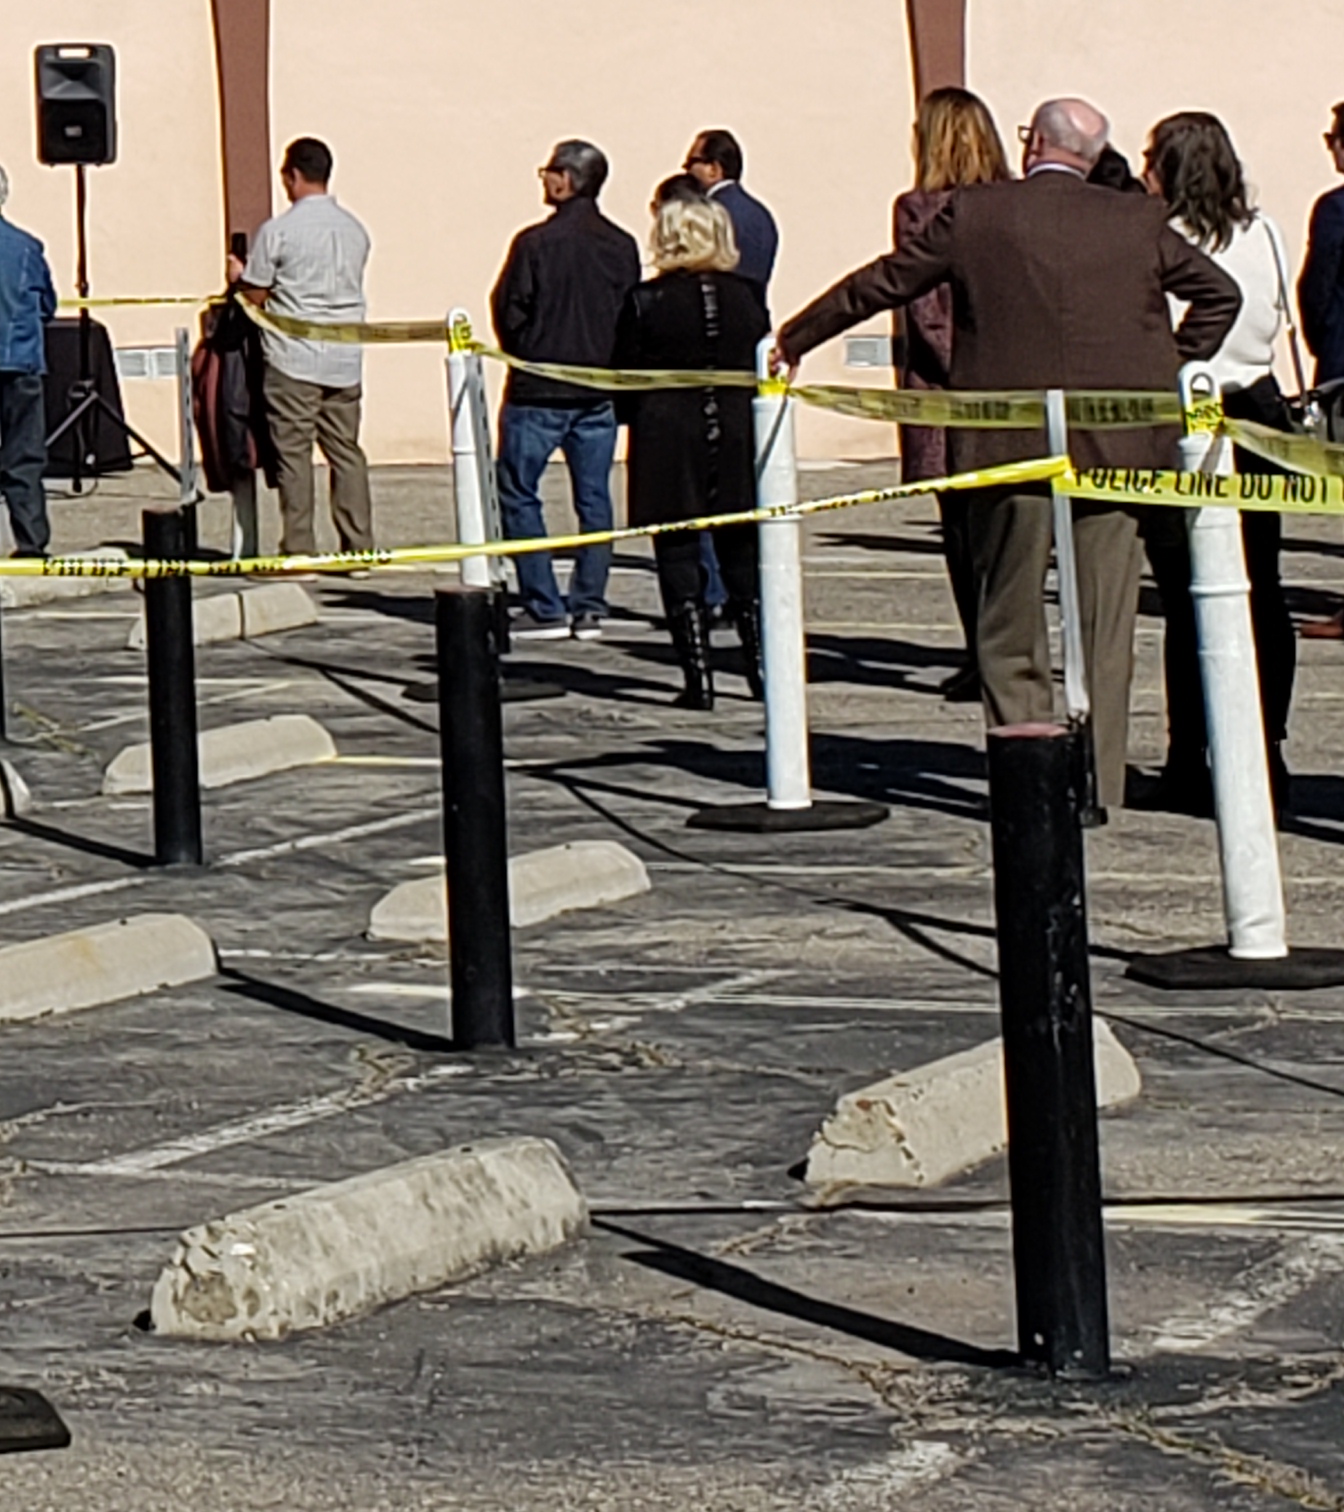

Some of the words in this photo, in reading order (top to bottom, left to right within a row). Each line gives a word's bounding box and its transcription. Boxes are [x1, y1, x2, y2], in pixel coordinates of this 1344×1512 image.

[1174, 469, 1229, 499] LINE
[1240, 473, 1272, 502] DO
[1282, 474, 1328, 505] NOT
